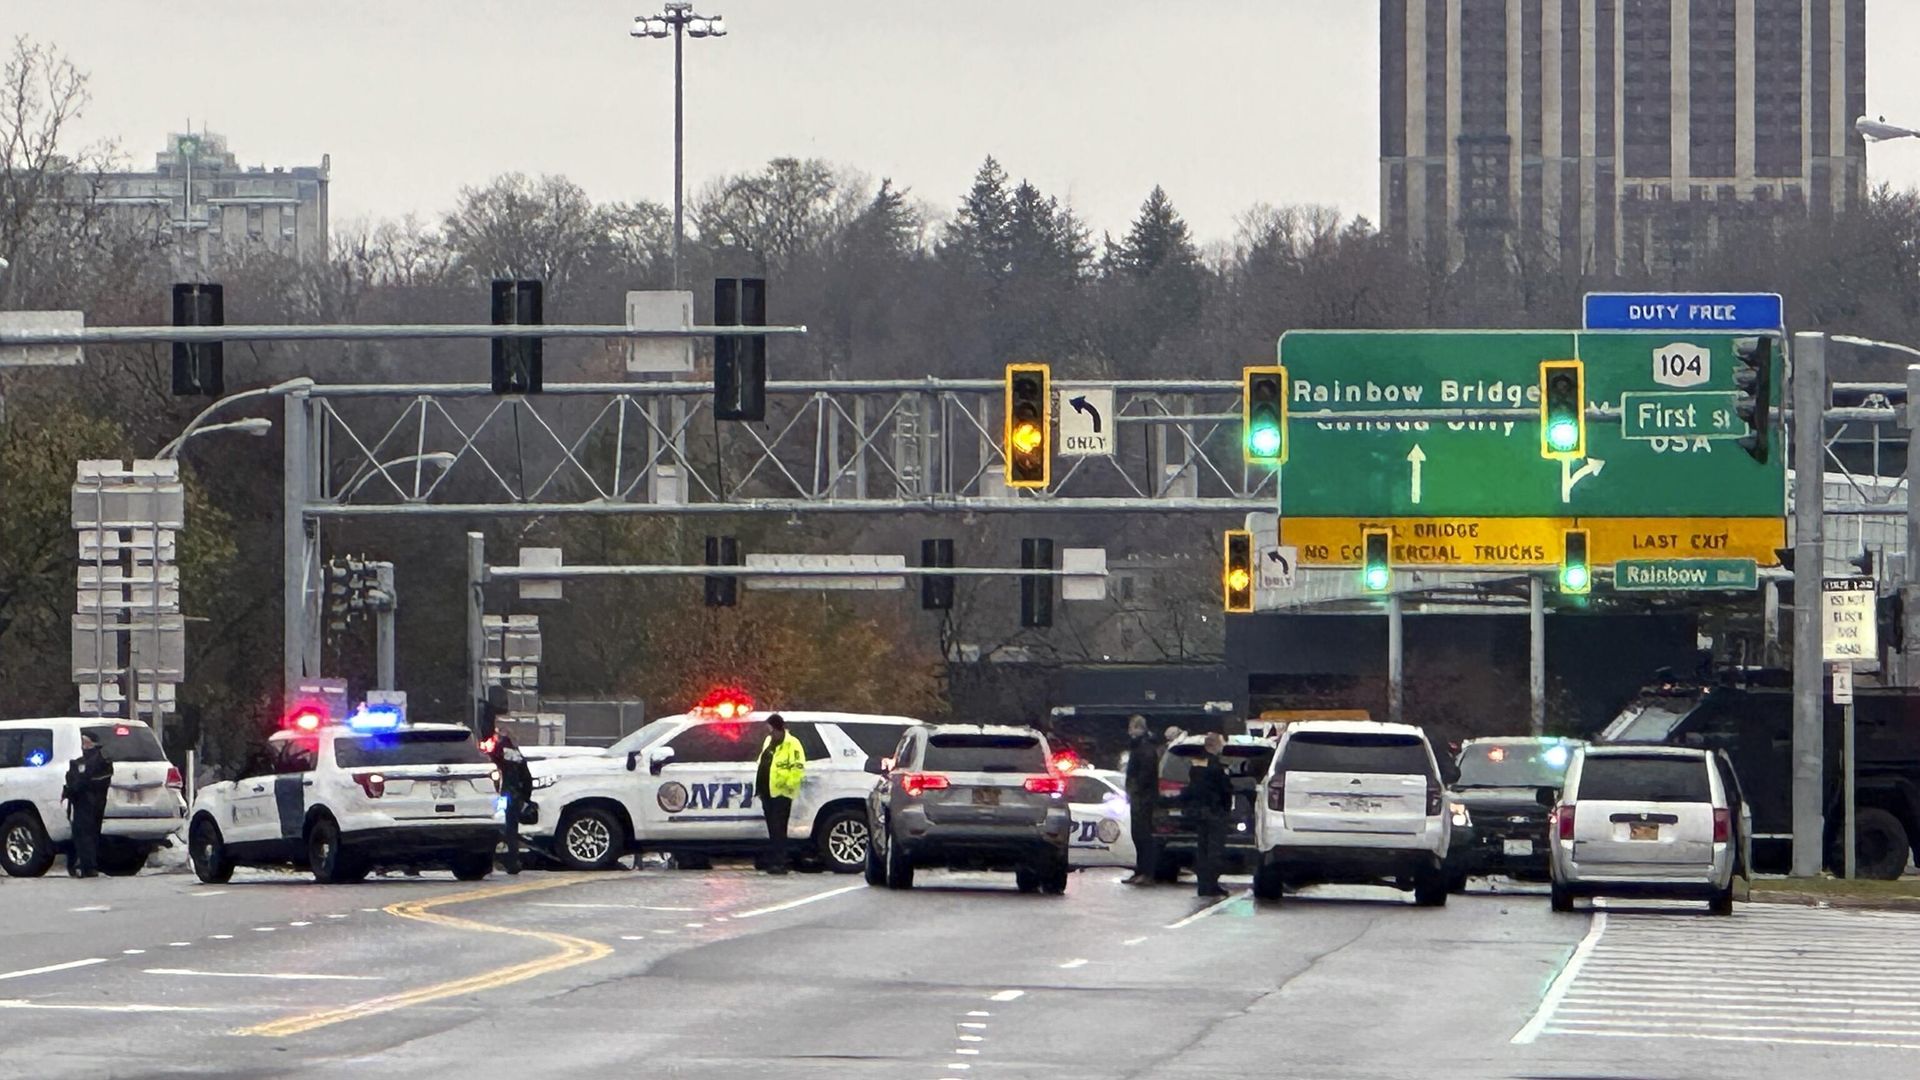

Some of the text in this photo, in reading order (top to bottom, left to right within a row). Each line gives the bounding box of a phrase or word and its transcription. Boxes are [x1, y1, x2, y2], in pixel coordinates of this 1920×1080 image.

[1629, 304, 1737, 320] DUTY FREE
[1661, 354, 1702, 377] 104
[1294, 380, 1542, 408] Rainbow Bridge
[1638, 403, 1697, 429] First
[1066, 436, 1107, 450] ONLY
[1650, 437, 1712, 453] USA
[1414, 523, 1479, 539] BRIDGE
[1633, 534, 1729, 549] LAST EXIT
[1304, 545, 1545, 560] NO COERCIAL TRUCKS
[1626, 566, 1708, 584] Rainbow
